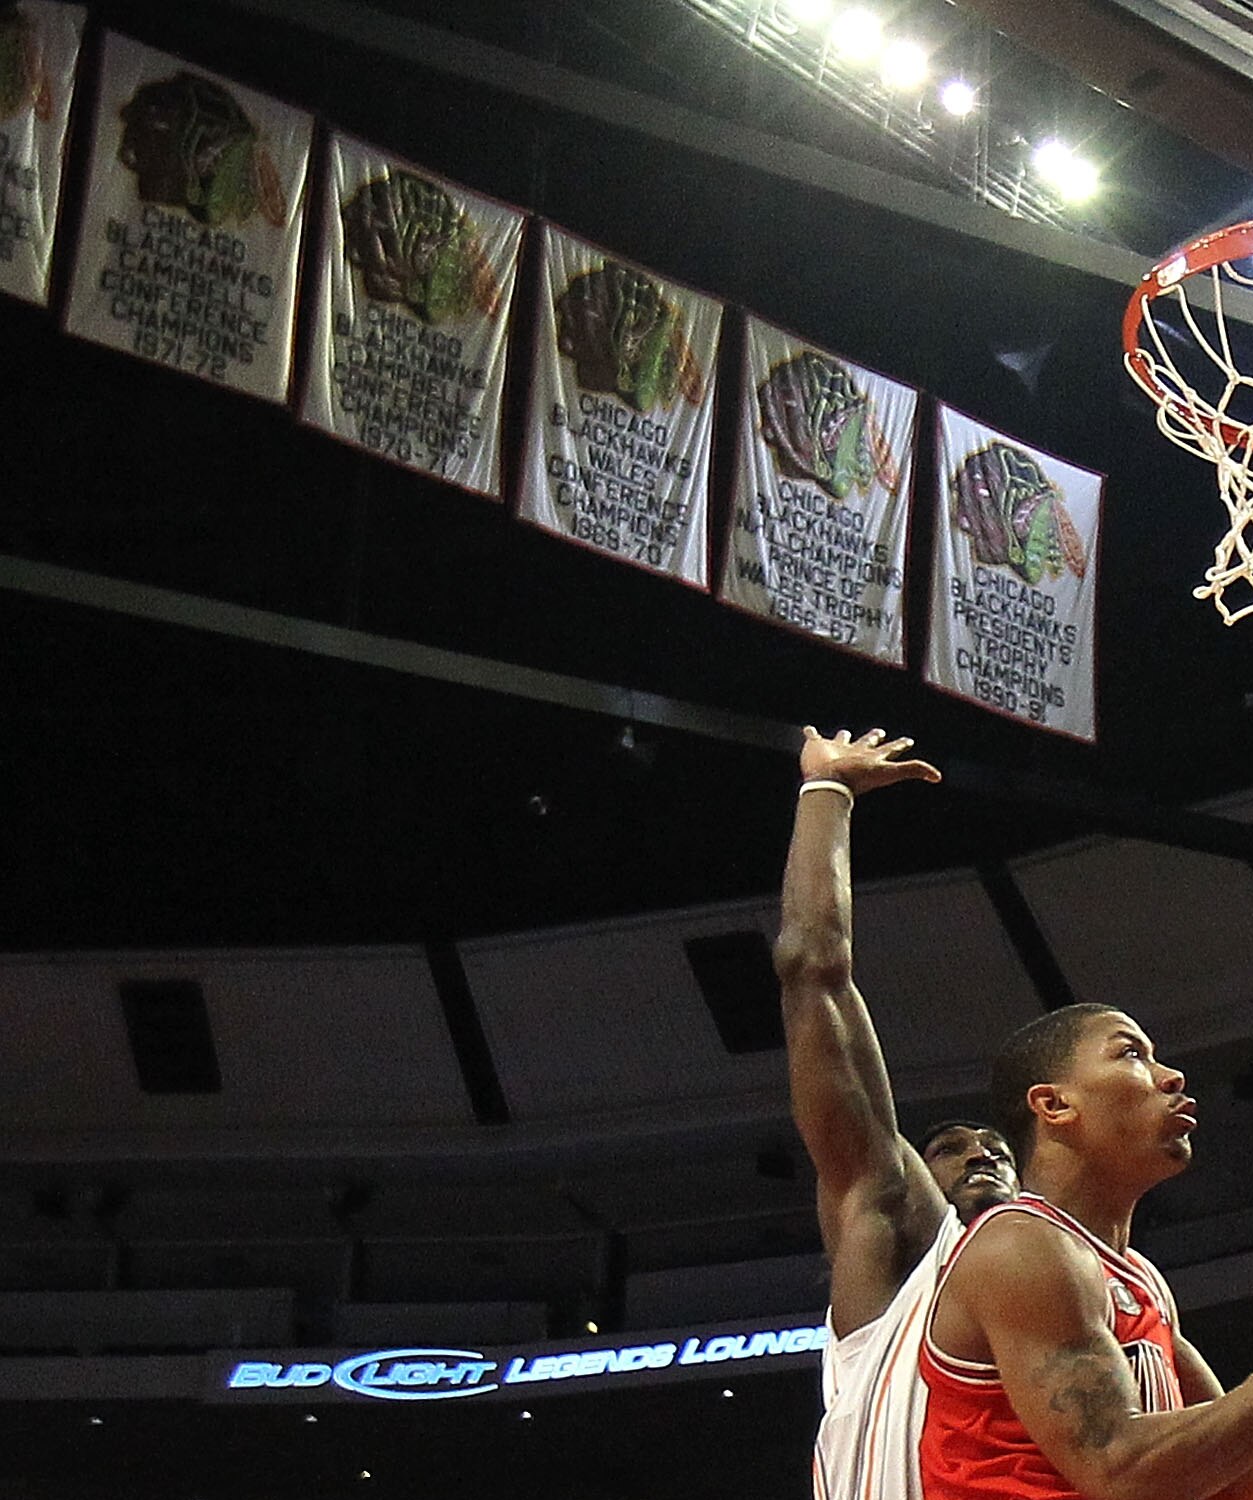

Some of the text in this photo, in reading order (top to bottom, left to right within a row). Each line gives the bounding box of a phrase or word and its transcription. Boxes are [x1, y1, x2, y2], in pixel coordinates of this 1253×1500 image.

[107, 218, 273, 298] BLACKHAWKS
[143, 206, 246, 262] CHICAGO
[367, 303, 462, 358] CHICAGO
[552, 403, 691, 479] BLACKHAWKS
[580, 393, 667, 447] CHICAGO
[549, 455, 688, 526] CONFERENCE
[588, 445, 657, 491] WALES
[557, 482, 678, 547] CHAMPIONS
[780, 480, 864, 532] CHICAGO
[812, 584, 893, 632] TROPHY
[951, 577, 1078, 645] BLACKHAWKS
[975, 566, 1056, 616] CHICAGO
[957, 648, 1065, 708] CHAMPIONS
[974, 632, 1049, 680] TROPHY
[229, 1362, 332, 1388] BUD
[360, 1361, 498, 1386] LIGHT
[504, 1342, 676, 1384] LEGENDS
